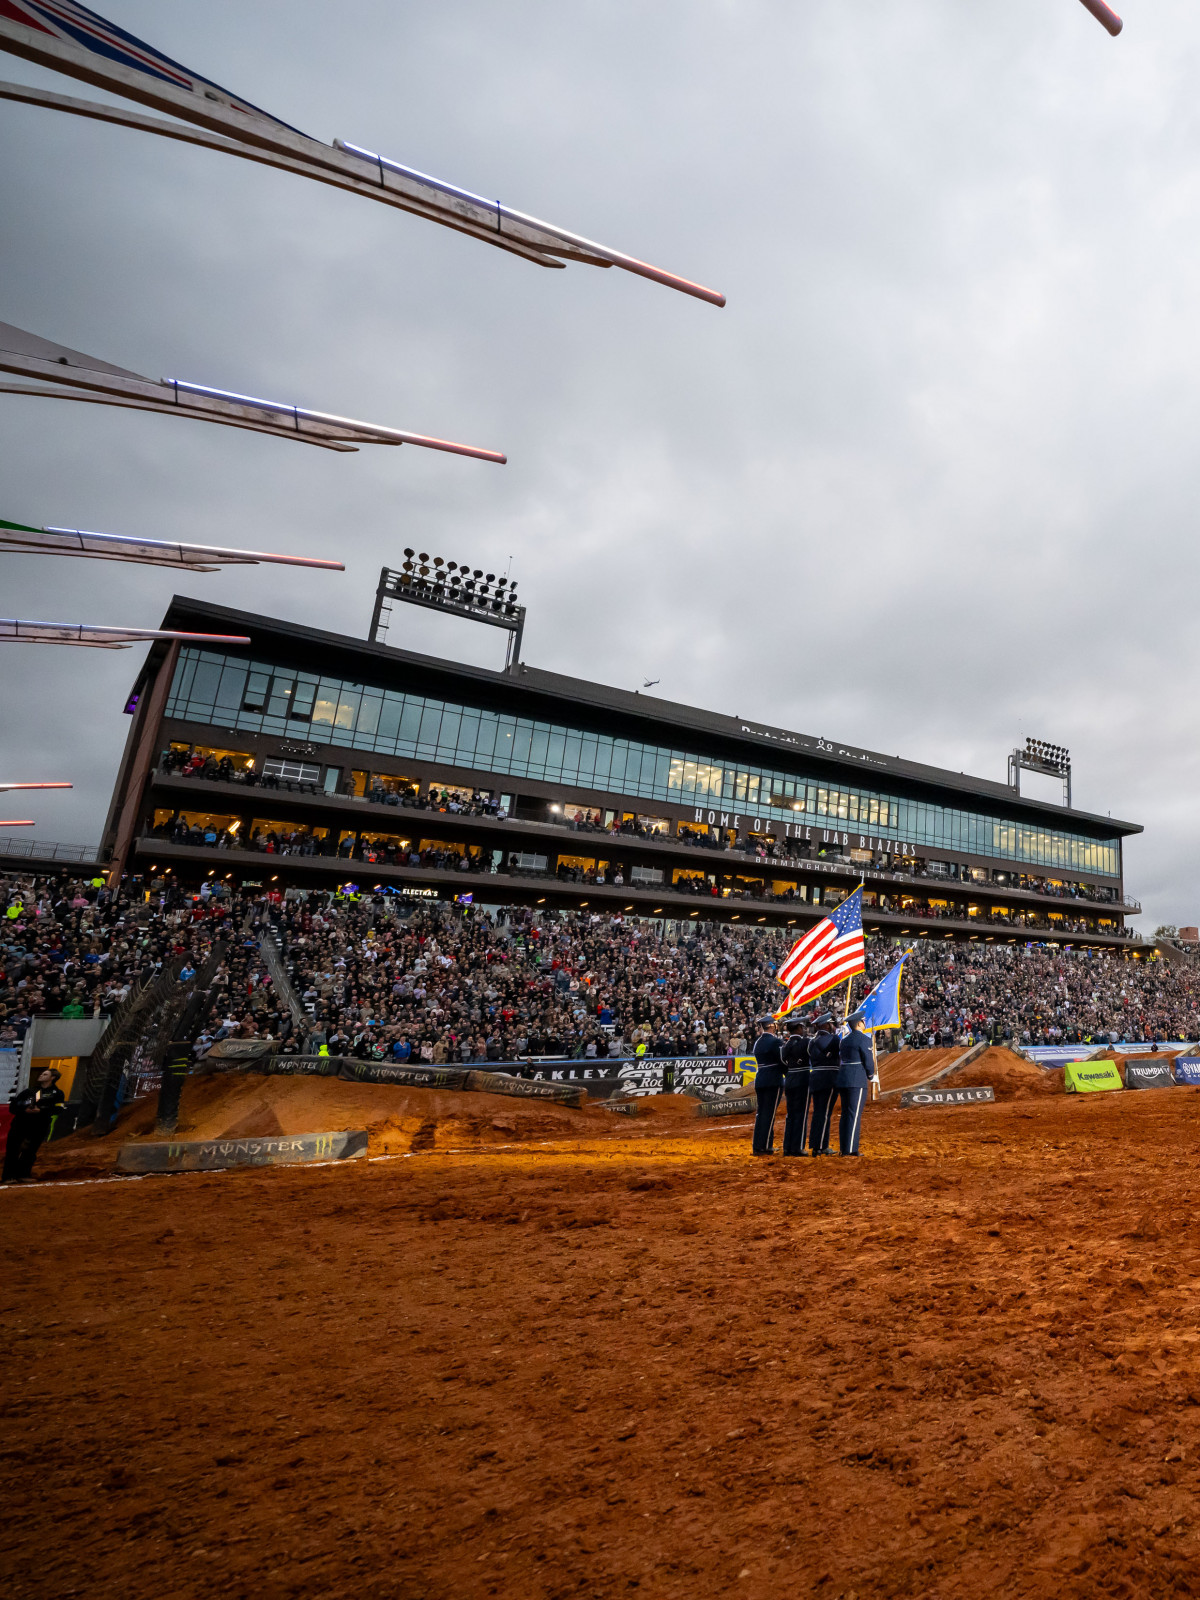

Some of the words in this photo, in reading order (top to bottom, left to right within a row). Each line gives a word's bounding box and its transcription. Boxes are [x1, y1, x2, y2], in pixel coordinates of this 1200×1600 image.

[694, 808, 740, 829] HOME
[754, 818, 772, 834] OF
[785, 823, 811, 840] THE
[823, 830, 849, 846] UAB
[859, 836, 916, 857] BLAZERS
[755, 856, 838, 873] BIRMINGHAM
[845, 868, 885, 880] LEGION
[674, 1059, 728, 1069] MOUNTAIN
[369, 1068, 430, 1082] MONSTER
[1077, 1070, 1115, 1081] Kawasaki
[1131, 1067, 1164, 1077] TRIUMPH
[682, 1075, 742, 1086] MOUNTAIN
[934, 1090, 992, 1102] OAKLEY
[711, 1100, 748, 1110] MONSTER
[200, 1139, 305, 1156] MONSTER
